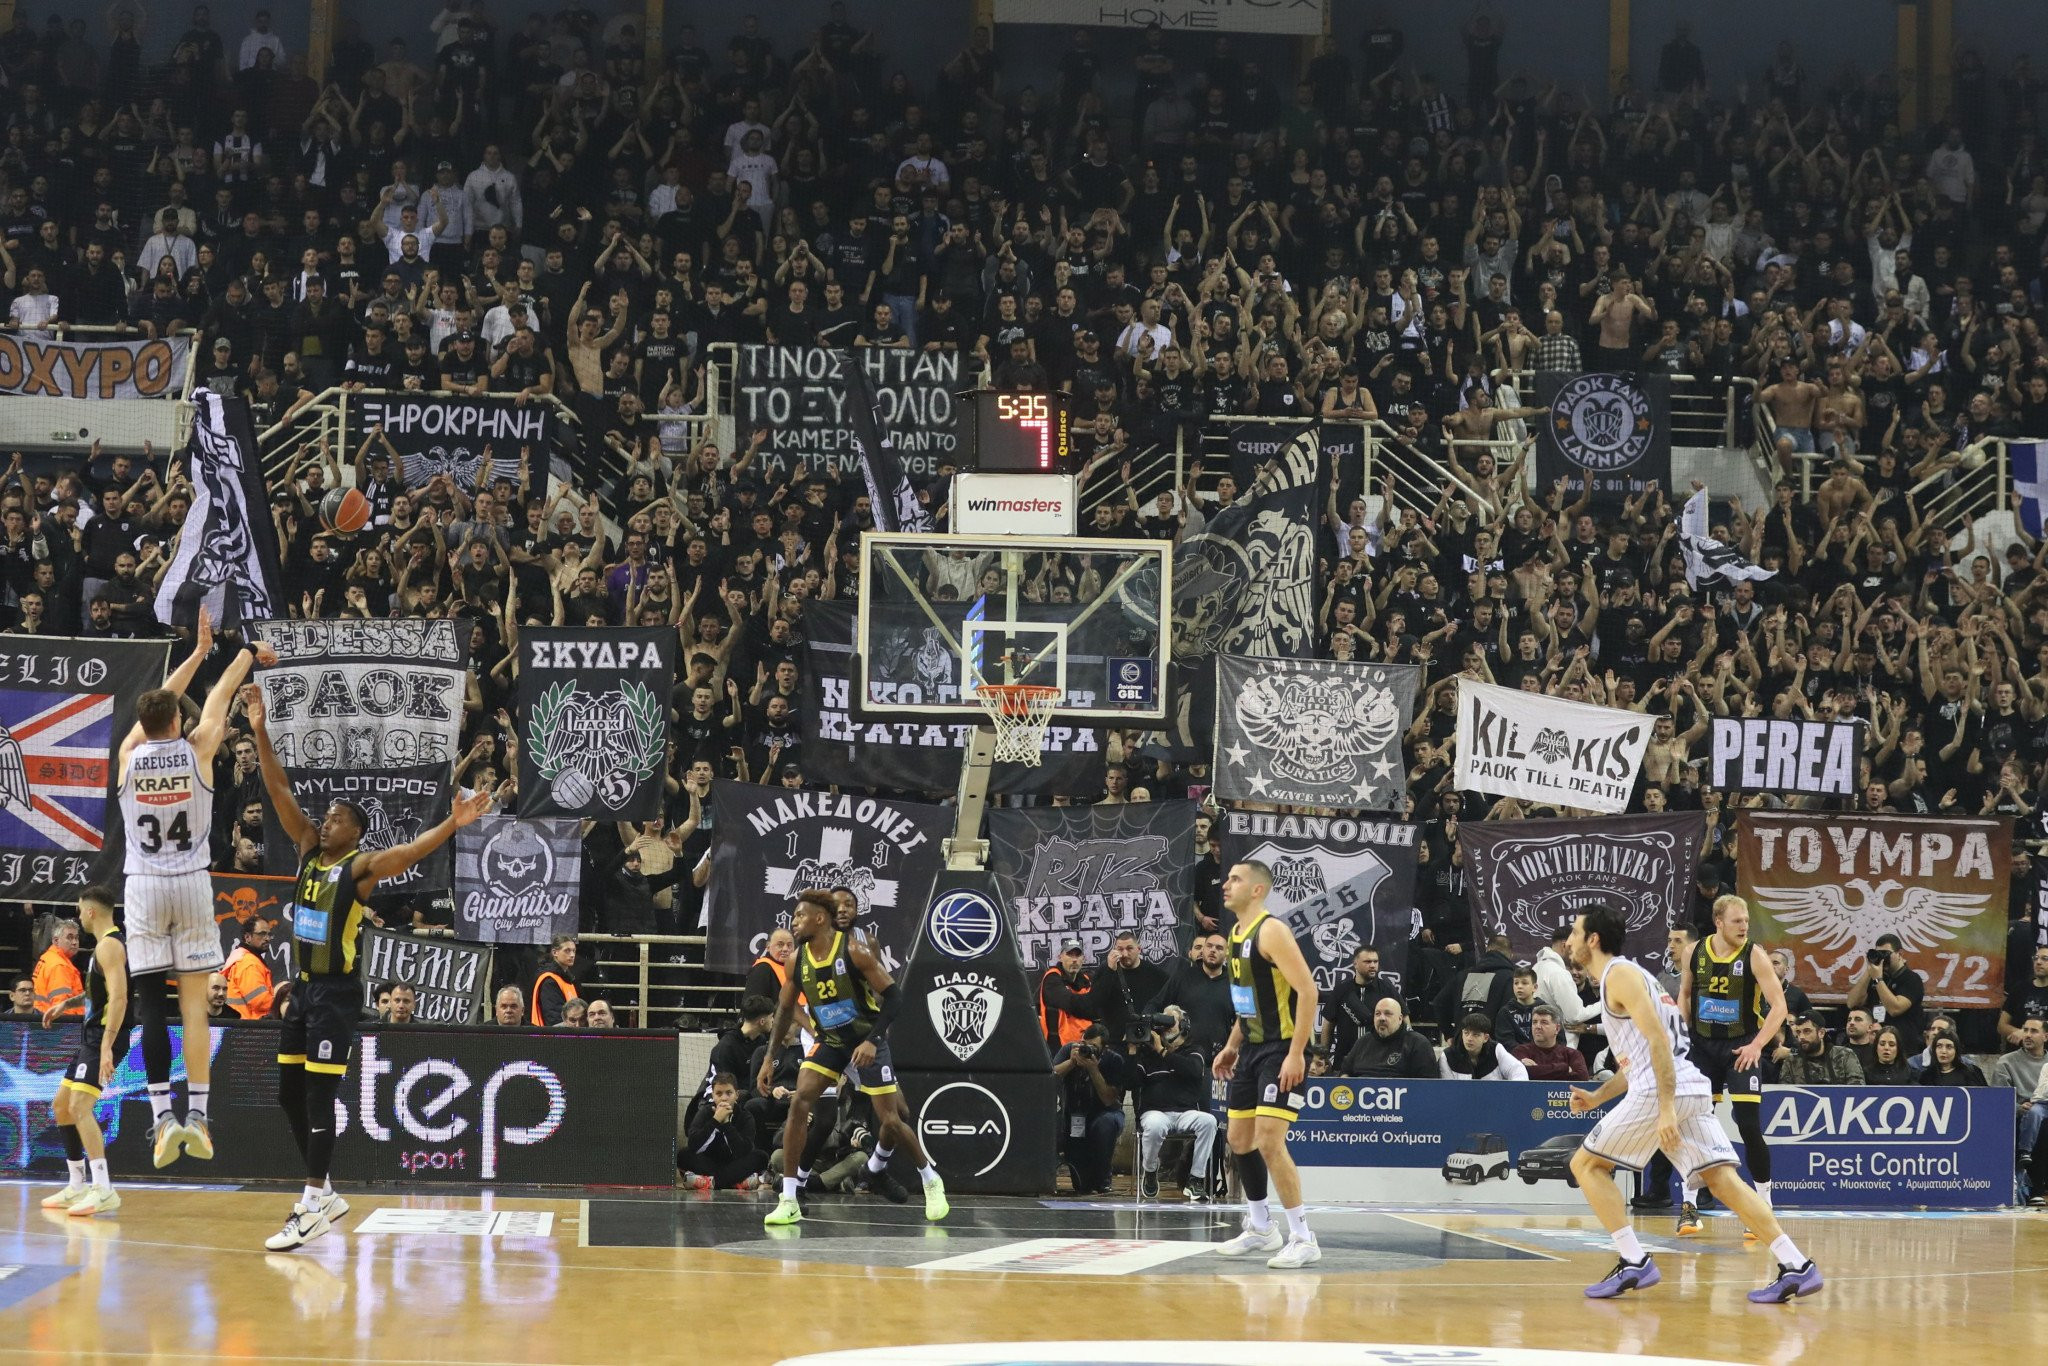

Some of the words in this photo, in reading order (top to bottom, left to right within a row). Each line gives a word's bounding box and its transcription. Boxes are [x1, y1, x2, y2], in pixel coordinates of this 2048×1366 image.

[1100, 8, 1218, 28] HOME
[743, 344, 845, 380] ΤΙΝΟΣ
[741, 386, 791, 424] ΤΟ
[803, 386, 957, 427] ΞΥΟΛΙΟ,
[998, 395, 1048, 419] 5:35
[1557, 377, 1604, 415] PAOK
[1609, 378, 1649, 416] FANS
[363, 403, 545, 441] ΞΗΡΟΚΡΗΝΗ
[1058, 410, 1069, 456] Quince
[773, 429, 861, 450] ΚΑΜΕΡΕ
[890, 430, 957, 452] ΠΑΝΤΟ
[1562, 435, 1646, 467] LARNACA
[748, 452, 786, 472] ΤΑ
[968, 497, 1062, 512] winmasters
[254, 619, 460, 662] EDESSA
[531, 641, 663, 669] ΣΚΥΔΡΑ
[265, 669, 454, 722] PAOK
[1118, 690, 1142, 699] GBL
[134, 754, 189, 771] KREUSER
[1276, 756, 1350, 781] LUNATICS
[1712, 718, 1854, 795] PEREA
[134, 776, 190, 792] KRAFT
[294, 776, 438, 796] .MYLOTOPOS
[1471, 760, 1518, 782] PAOK
[1526, 768, 1563, 789] TILL
[1569, 776, 1626, 800] DEATH
[137, 811, 193, 854] 34
[747, 791, 927, 855] ΜΑΚΕΔΟΝΕΣ
[1228, 812, 1417, 847] ΕΠΑΝΟΜΗ
[378, 864, 424, 889] AOK
[1472, 848, 1486, 899] MADE
[1506, 843, 1664, 888] NORTHERNERS
[304, 878, 320, 902] 21
[1551, 874, 1581, 885] PAOK
[1588, 873, 1618, 884] FANS
[463, 887, 573, 923] Giannitsa
[1015, 889, 1180, 934] ΚΡΑΤΑ
[1287, 883, 1359, 937] 926
[494, 918, 513, 932] City
[516, 917, 543, 929] Alone
[817, 979, 838, 1000] 23
[933, 971, 998, 991] Π.Α.Ο.Κ.
[1709, 976, 1729, 994] 22
[1709, 1005, 1735, 1014] Midea
[953, 1045, 974, 1053] 1926
[333, 1034, 568, 1179] tep
[1358, 1086, 1408, 1110] car
[1547, 1091, 1574, 1099] ΚΛΕΙΣ
[1342, 1113, 1371, 1123] electric
[1372, 1113, 1404, 1123] vehicles
[1764, 1096, 1953, 1135] ΑΛΚΩΝ
[1285, 1130, 1307, 1142] 0%
[1310, 1130, 1379, 1145] Ηλεκτρικά
[1382, 1131, 1442, 1146] Οχήματα
[400, 1148, 467, 1175] sport
[1809, 1152, 1863, 1176] Pest
[1870, 1152, 1960, 1176] Control
[1770, 1179, 1826, 1191] πεντομώσεις
[1839, 1178, 1891, 1191] Μυοκτονίες
[1906, 1178, 1962, 1191] Αρωματισμός
[1963, 1178, 1991, 1191] Χώρου
